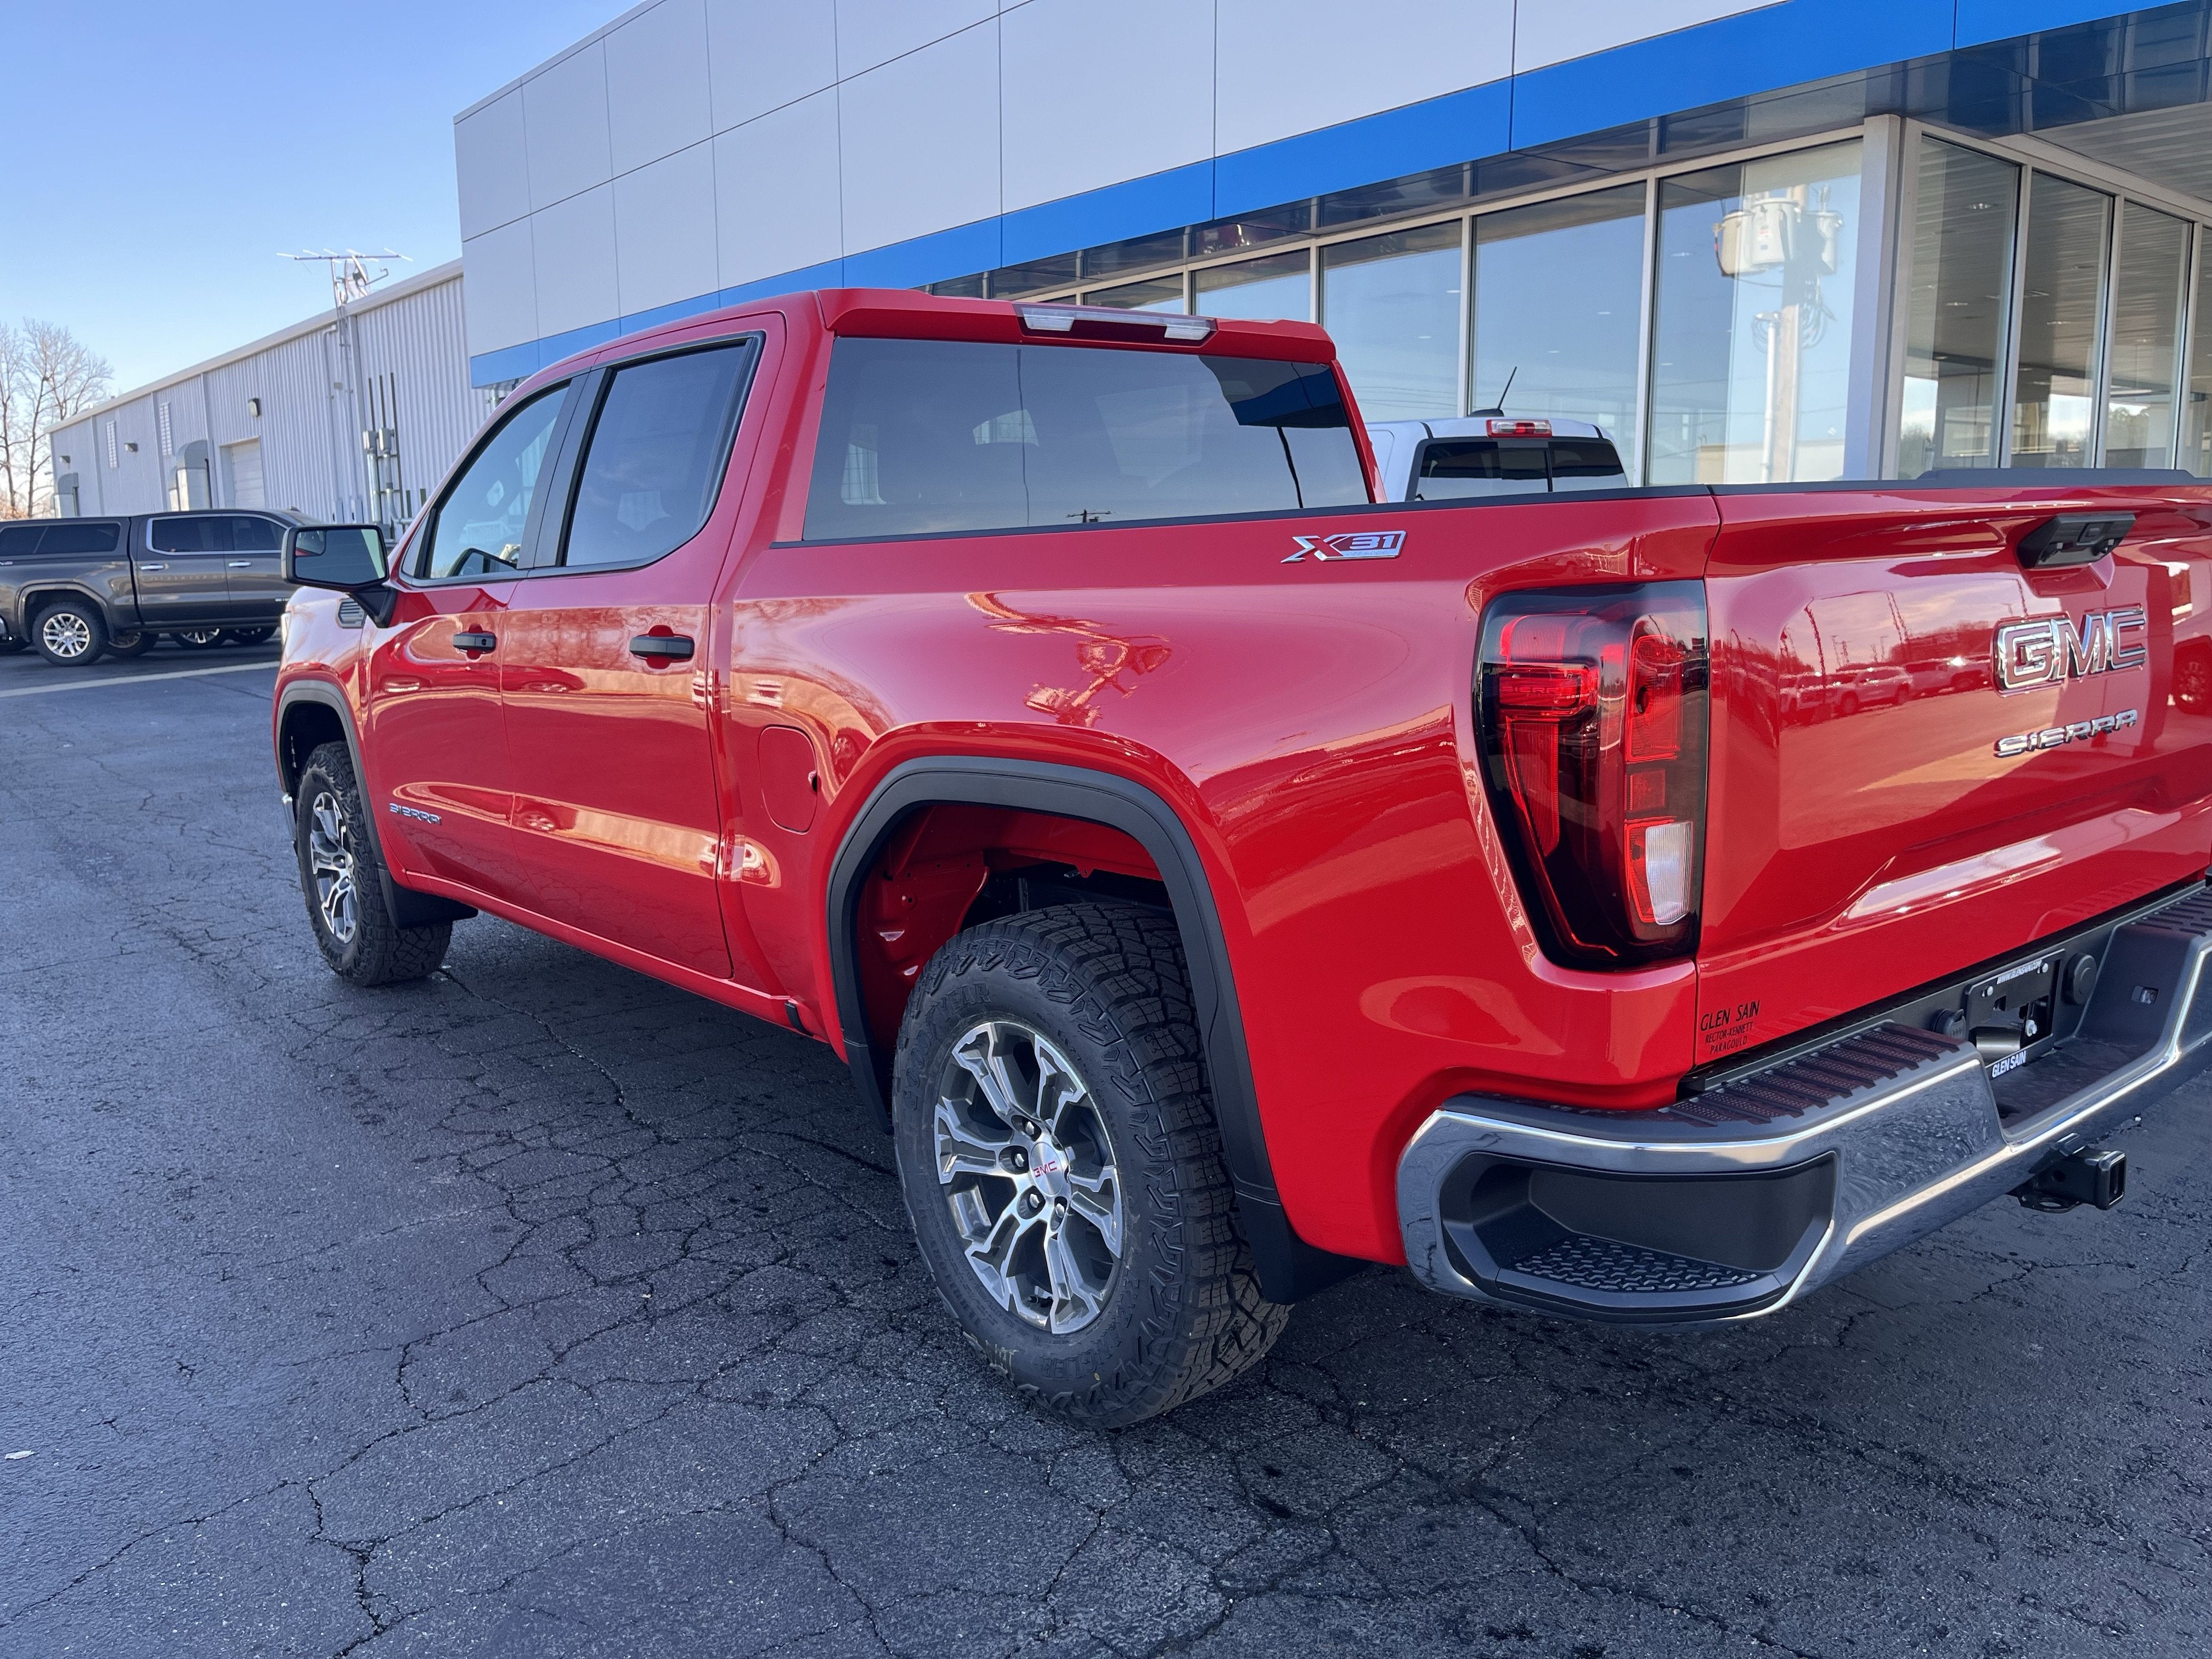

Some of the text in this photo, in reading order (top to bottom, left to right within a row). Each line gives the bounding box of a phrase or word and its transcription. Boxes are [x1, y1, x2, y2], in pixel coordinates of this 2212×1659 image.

[1280, 531, 1407, 562] X31
[1994, 608, 2146, 689] GMC
[1994, 709, 2138, 758] SIERRA
[390, 803, 442, 826] SIERRA
[1701, 1000, 1760, 1031] GLEN SAIN
[1710, 1036, 1747, 1055] PARAGOULD
[1992, 1051, 2026, 1077] GLEN SAIN
[1033, 1160, 1058, 1178] GMC
